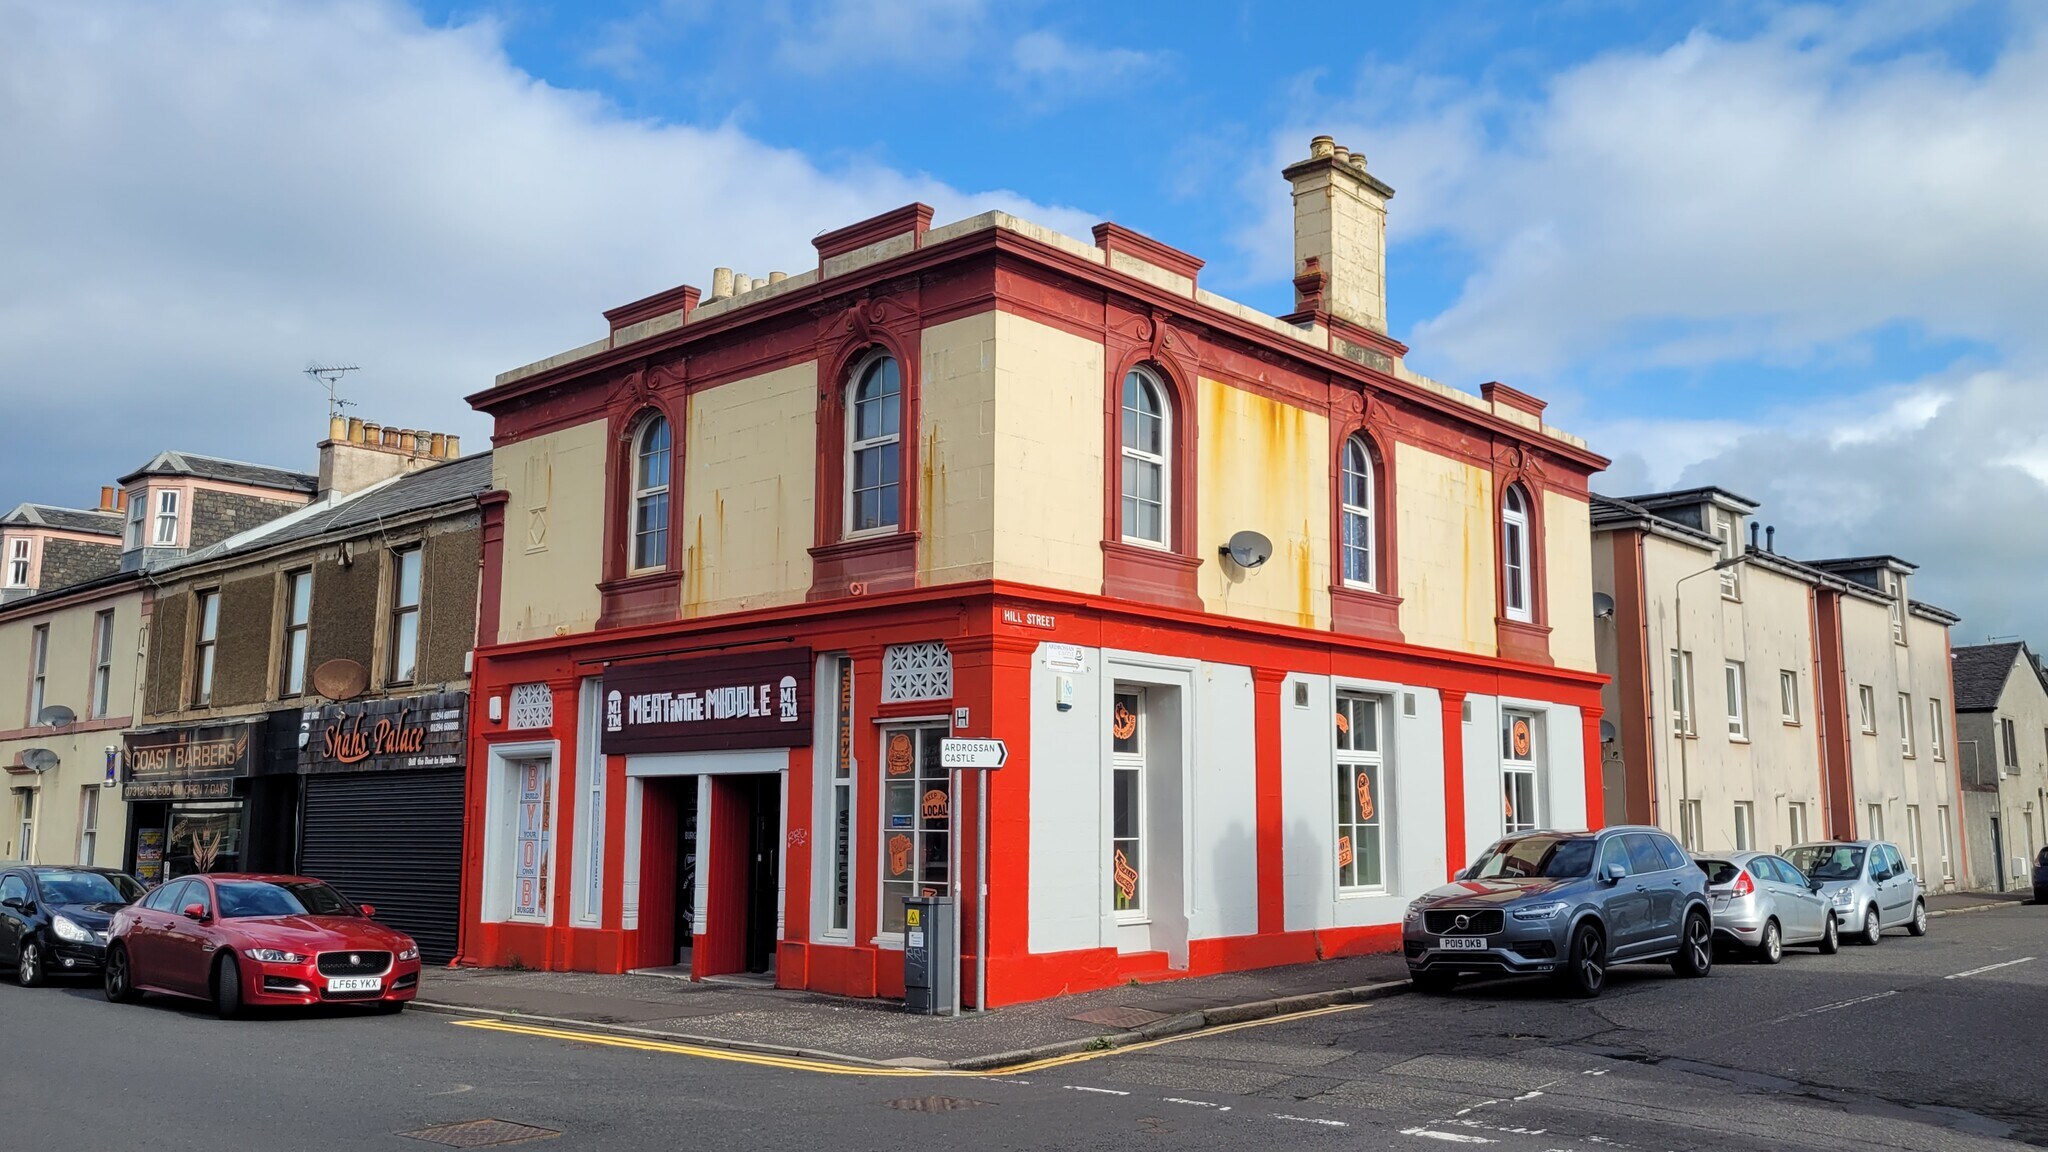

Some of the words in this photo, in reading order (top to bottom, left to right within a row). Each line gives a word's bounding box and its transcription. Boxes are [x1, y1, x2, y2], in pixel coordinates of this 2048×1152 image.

[1004, 610, 1022, 623] HILL
[1027, 613, 1055, 627] STREET
[629, 692, 672, 725] MEAT
[705, 684, 772, 720] MIDDLE
[956, 709, 968, 726] H
[322, 711, 369, 763] Shahs
[374, 708, 424, 754] Palace
[841, 717, 851, 769] FRESH
[132, 749, 171, 770] COAST
[175, 743, 235, 768] BARBERS
[944, 743, 995, 752] ARDROSSAN
[944, 753, 975, 762] CASTLE
[185, 783, 203, 795] OPEN
[204, 784, 209, 794] 7
[210, 783, 229, 794] DAYS
[527, 766, 537, 791] B
[925, 792, 937, 801] KEEP
[526, 804, 536, 830] Y
[923, 802, 948, 817] LOCAL
[523, 841, 534, 867] O
[521, 880, 532, 906] B
[839, 862, 849, 906] LOVE
[1465, 939, 1482, 948] OKB
[333, 979, 357, 989] LF66
[360, 979, 377, 988] YKX
